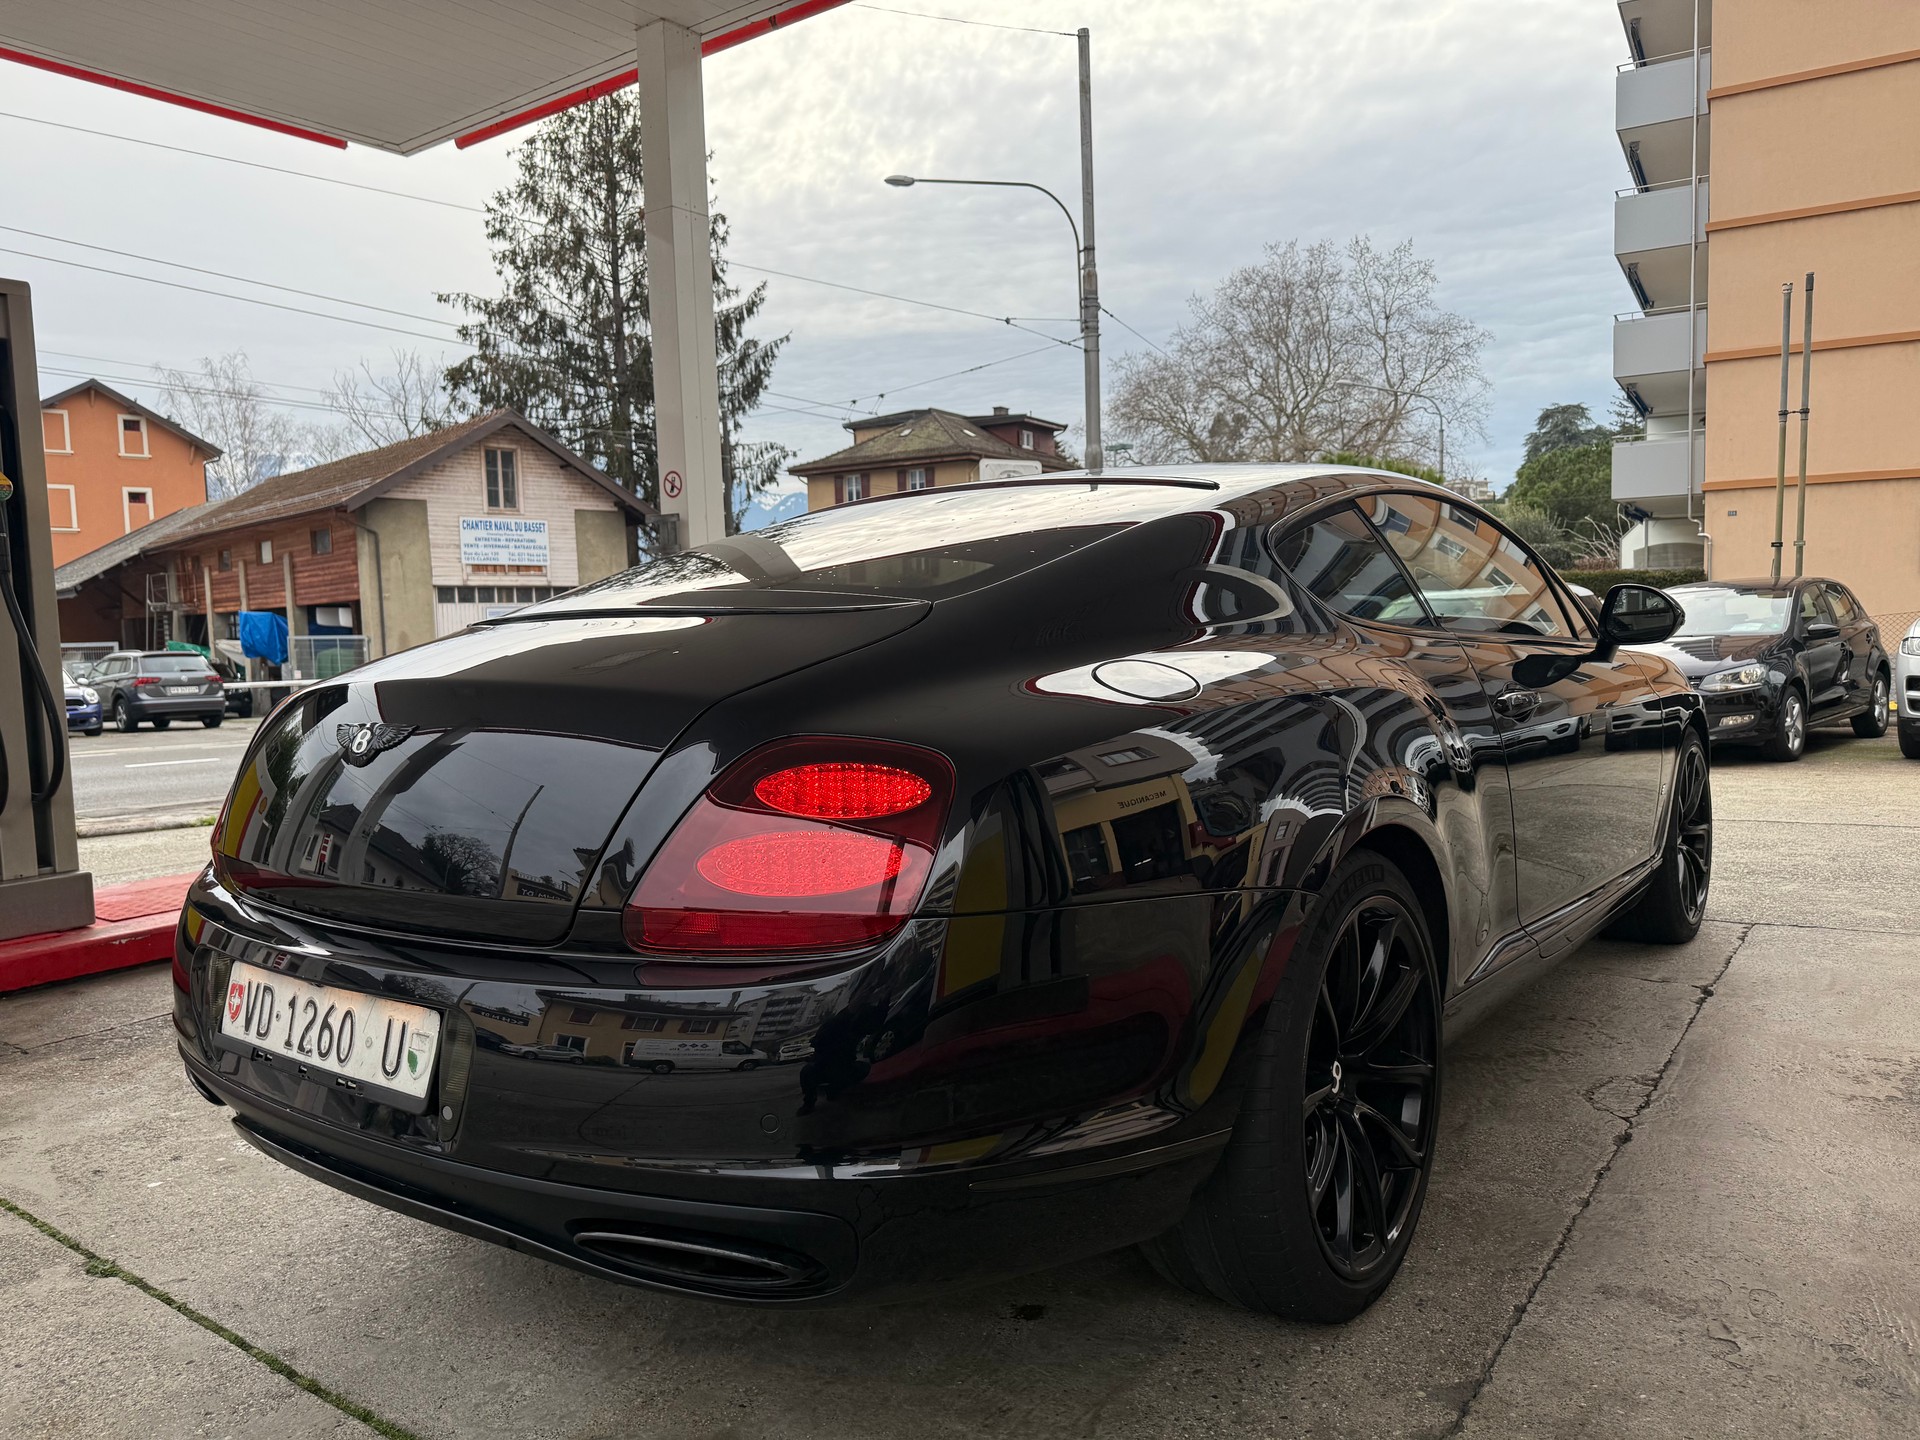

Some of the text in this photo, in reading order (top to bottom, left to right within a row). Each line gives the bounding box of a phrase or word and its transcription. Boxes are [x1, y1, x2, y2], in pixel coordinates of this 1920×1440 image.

[462, 519, 546, 533] CHANTIER NAVAL DU BASSET
[381, 1016, 408, 1080] U
